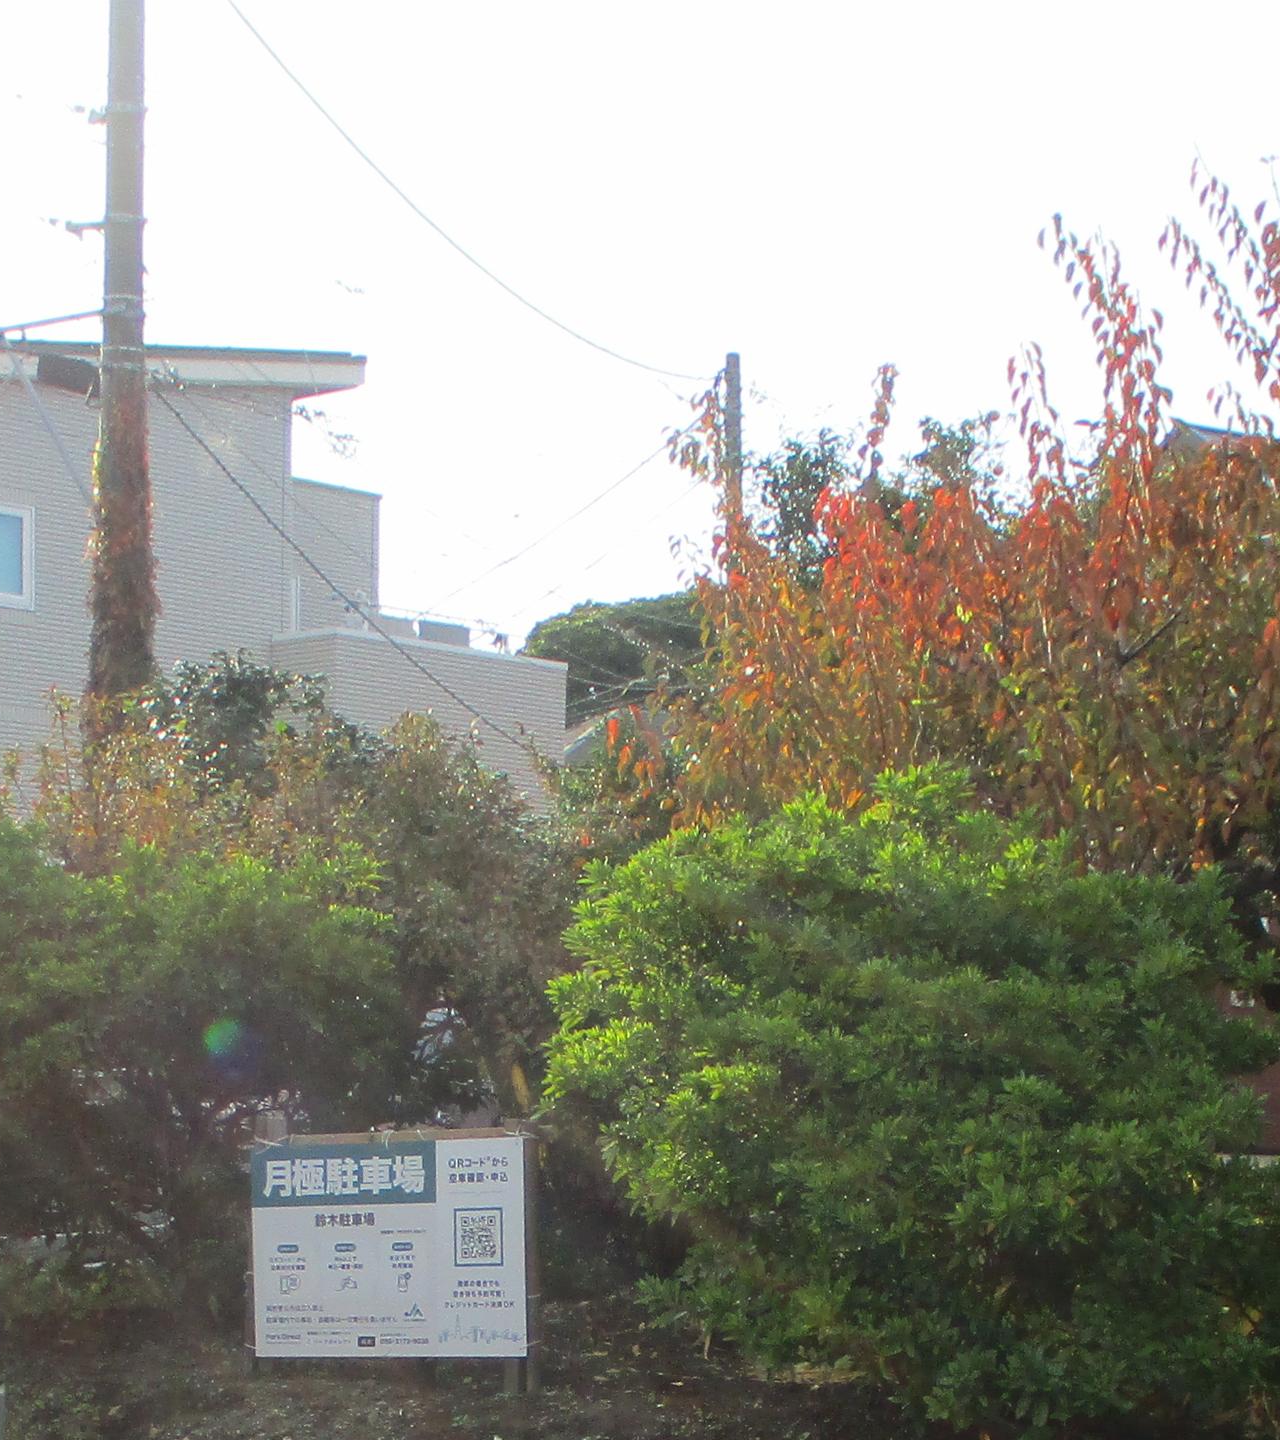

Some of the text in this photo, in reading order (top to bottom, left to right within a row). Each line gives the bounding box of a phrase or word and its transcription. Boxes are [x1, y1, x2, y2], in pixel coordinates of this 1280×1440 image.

[263, 1155, 426, 1198] 月極駐車場
[314, 1212, 376, 1228] 鈴木駐車場
